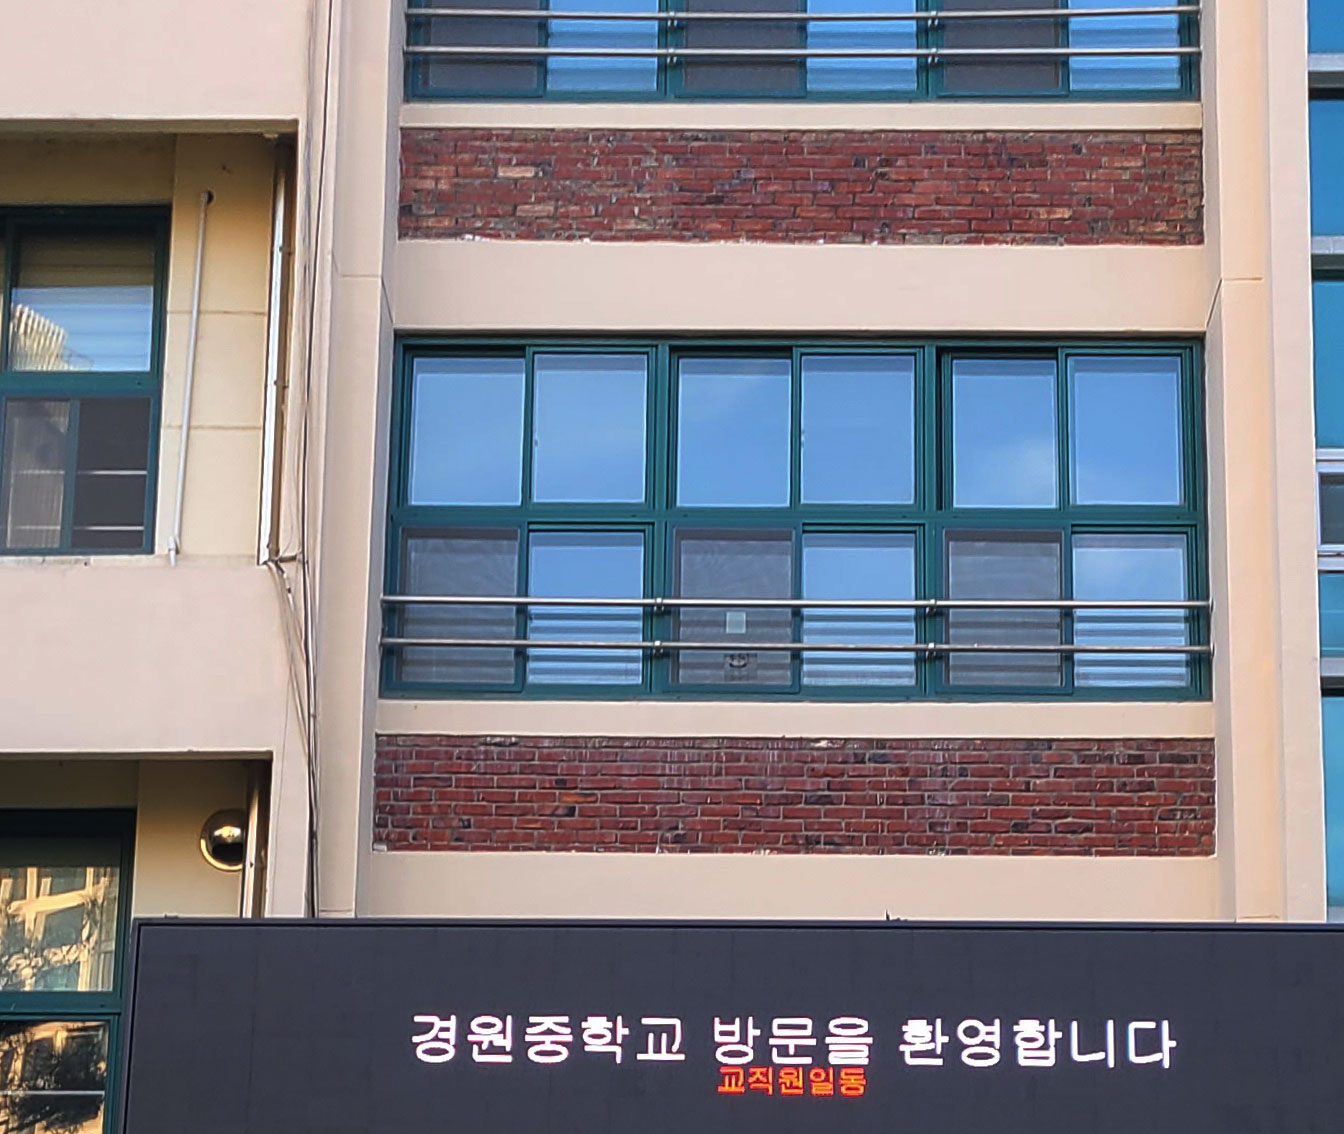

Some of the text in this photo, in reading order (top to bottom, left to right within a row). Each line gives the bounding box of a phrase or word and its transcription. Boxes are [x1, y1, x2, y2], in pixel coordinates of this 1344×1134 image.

[410, 1014, 1179, 1071] 경원중학교 방문을 환영합니다
[718, 1066, 868, 1097] 교직원일동
